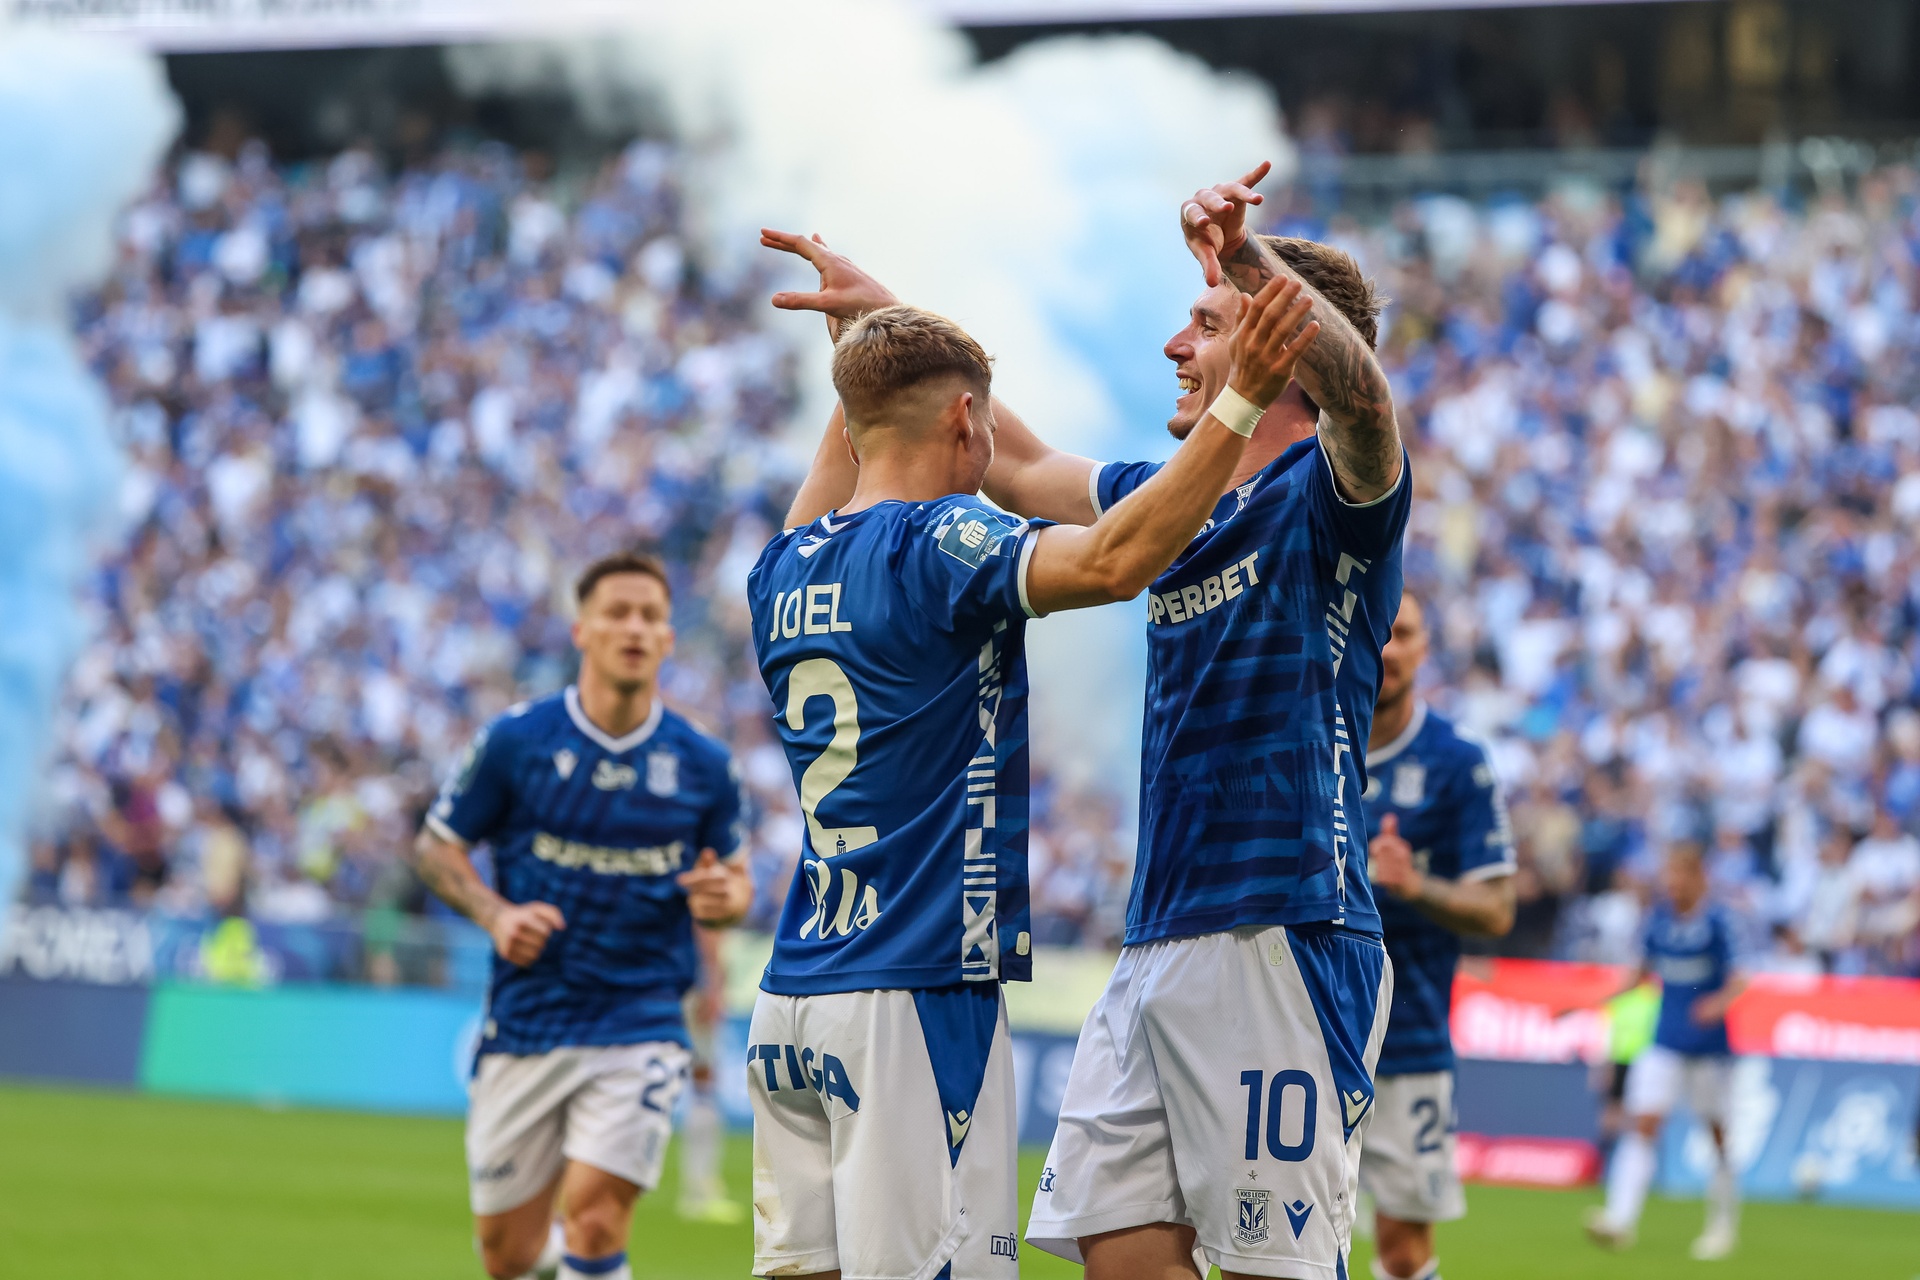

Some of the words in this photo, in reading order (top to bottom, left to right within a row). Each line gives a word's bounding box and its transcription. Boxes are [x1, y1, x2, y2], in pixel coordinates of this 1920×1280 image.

[770, 582, 852, 642] JOEL
[786, 657, 879, 859] 2
[1240, 1069, 1318, 1162] 10
